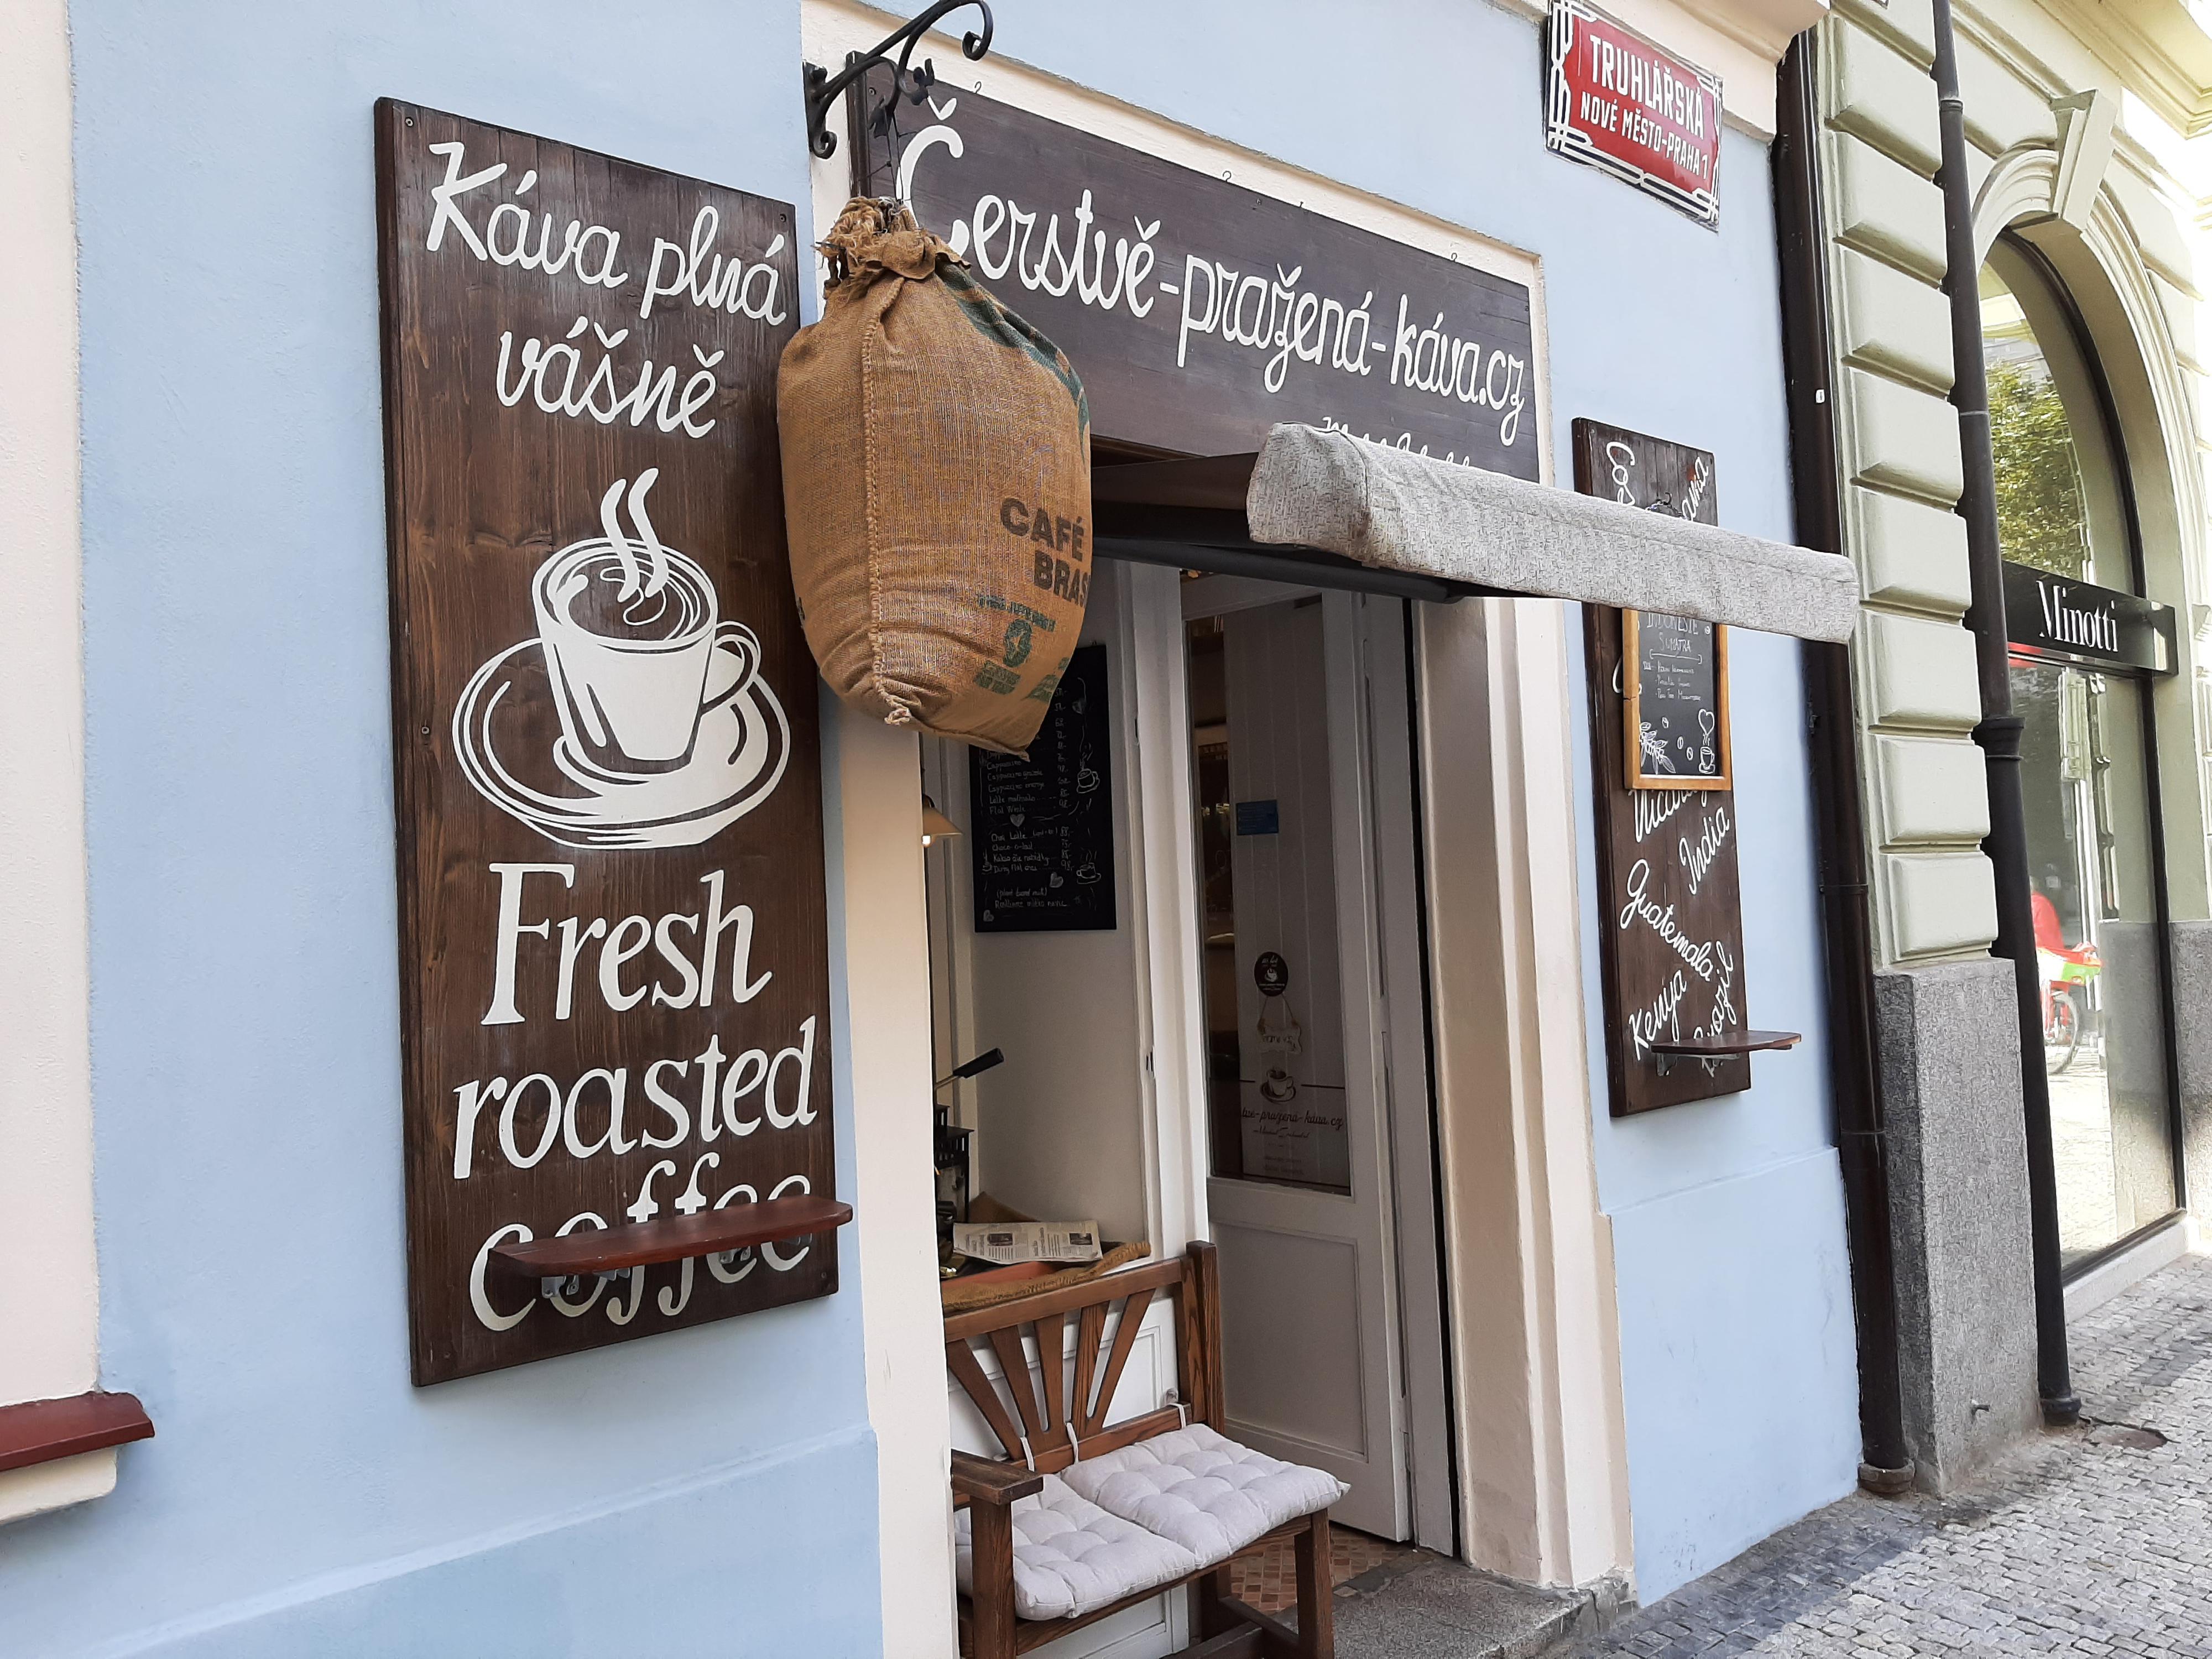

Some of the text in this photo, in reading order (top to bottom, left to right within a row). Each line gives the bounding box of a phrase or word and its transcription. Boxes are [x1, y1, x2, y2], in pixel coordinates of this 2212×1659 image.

[1580, 91, 1708, 179] NOVÉ MĚSTO-PRAHA 1
[1589, 34, 1704, 139] TRUHLÁŘSKÁ
[426, 142, 787, 326] Káva plná
[497, 316, 726, 439] vášně
[1000, 498, 1085, 562] CAFÉ
[2036, 580, 2119, 653] Minotti
[1679, 806, 1730, 896] India
[481, 862, 773, 1025] Fresh
[1620, 859, 1714, 982] Guatemala
[1628, 969, 1688, 1061] Kenya
[452, 1015, 818, 1180] roasted
[469, 1151, 813, 1332] coffee
